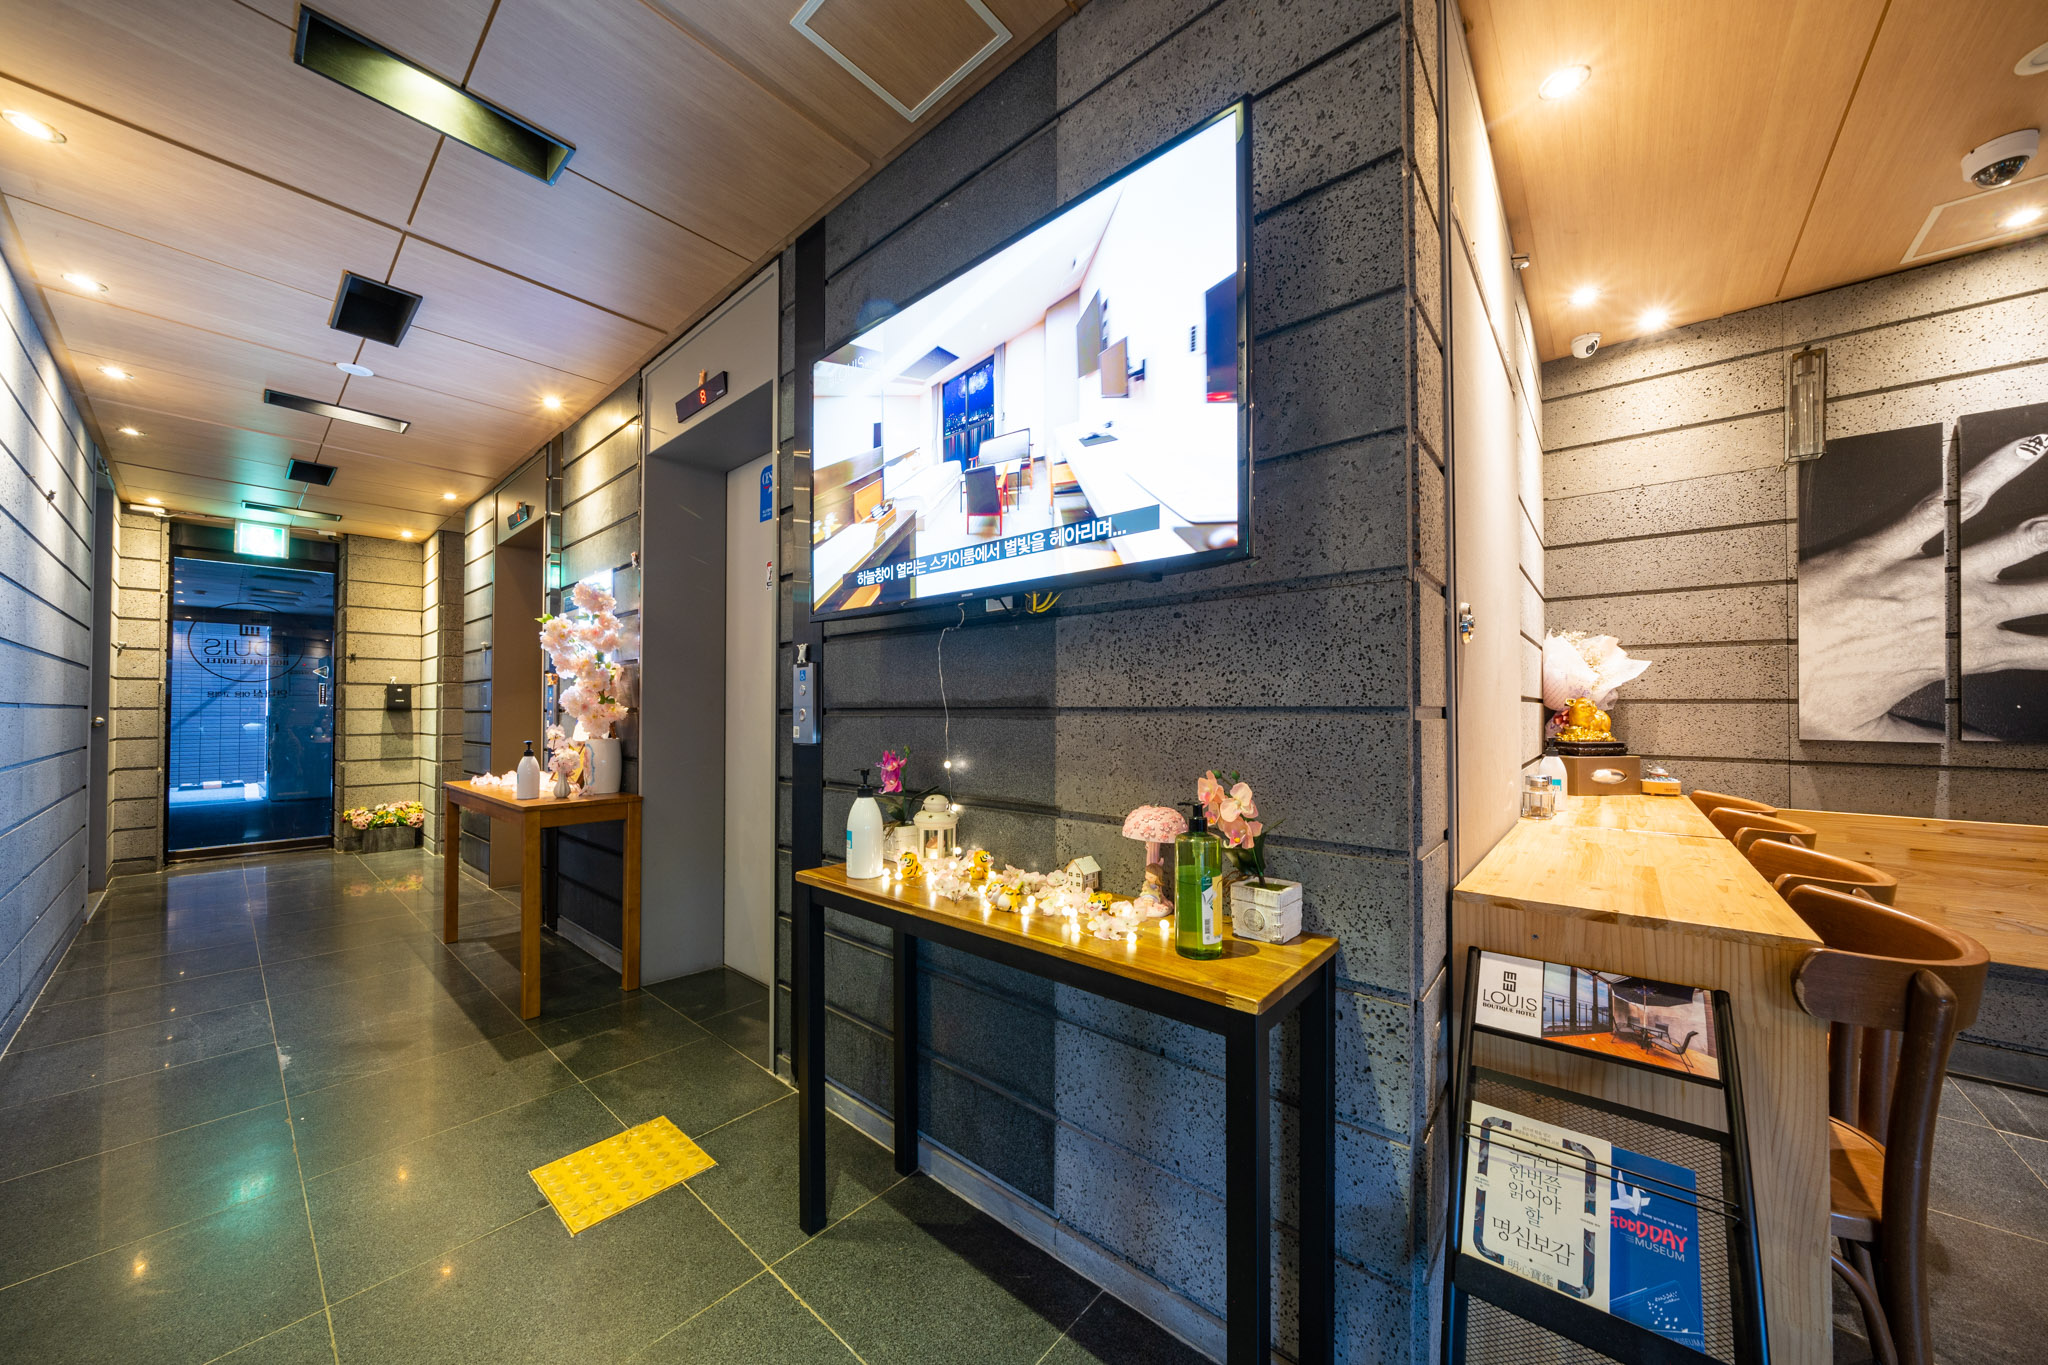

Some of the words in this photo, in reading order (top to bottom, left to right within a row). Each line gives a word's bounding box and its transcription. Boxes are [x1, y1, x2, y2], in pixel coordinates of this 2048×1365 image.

[699, 388, 707, 405] 8
[857, 565, 894, 585] 하늘창이
[896, 559, 927, 579] 열리는
[929, 541, 999, 570] 스카이룸에서
[1004, 532, 1045, 558] 별빛을
[1049, 517, 1127, 546] 헤아리며...
[1482, 1002, 1514, 1013] BOUTIQUE
[1515, 1009, 1536, 1018] HOTEL
[1483, 988, 1537, 1011] LOUIS
[1508, 1162, 1562, 1194] 한번쯤
[1508, 1182, 1562, 1215] 읽어야
[1525, 1206, 1544, 1228] 할
[1492, 1216, 1576, 1268] 명심보감
[1634, 1236, 1686, 1262] MUSEUM
